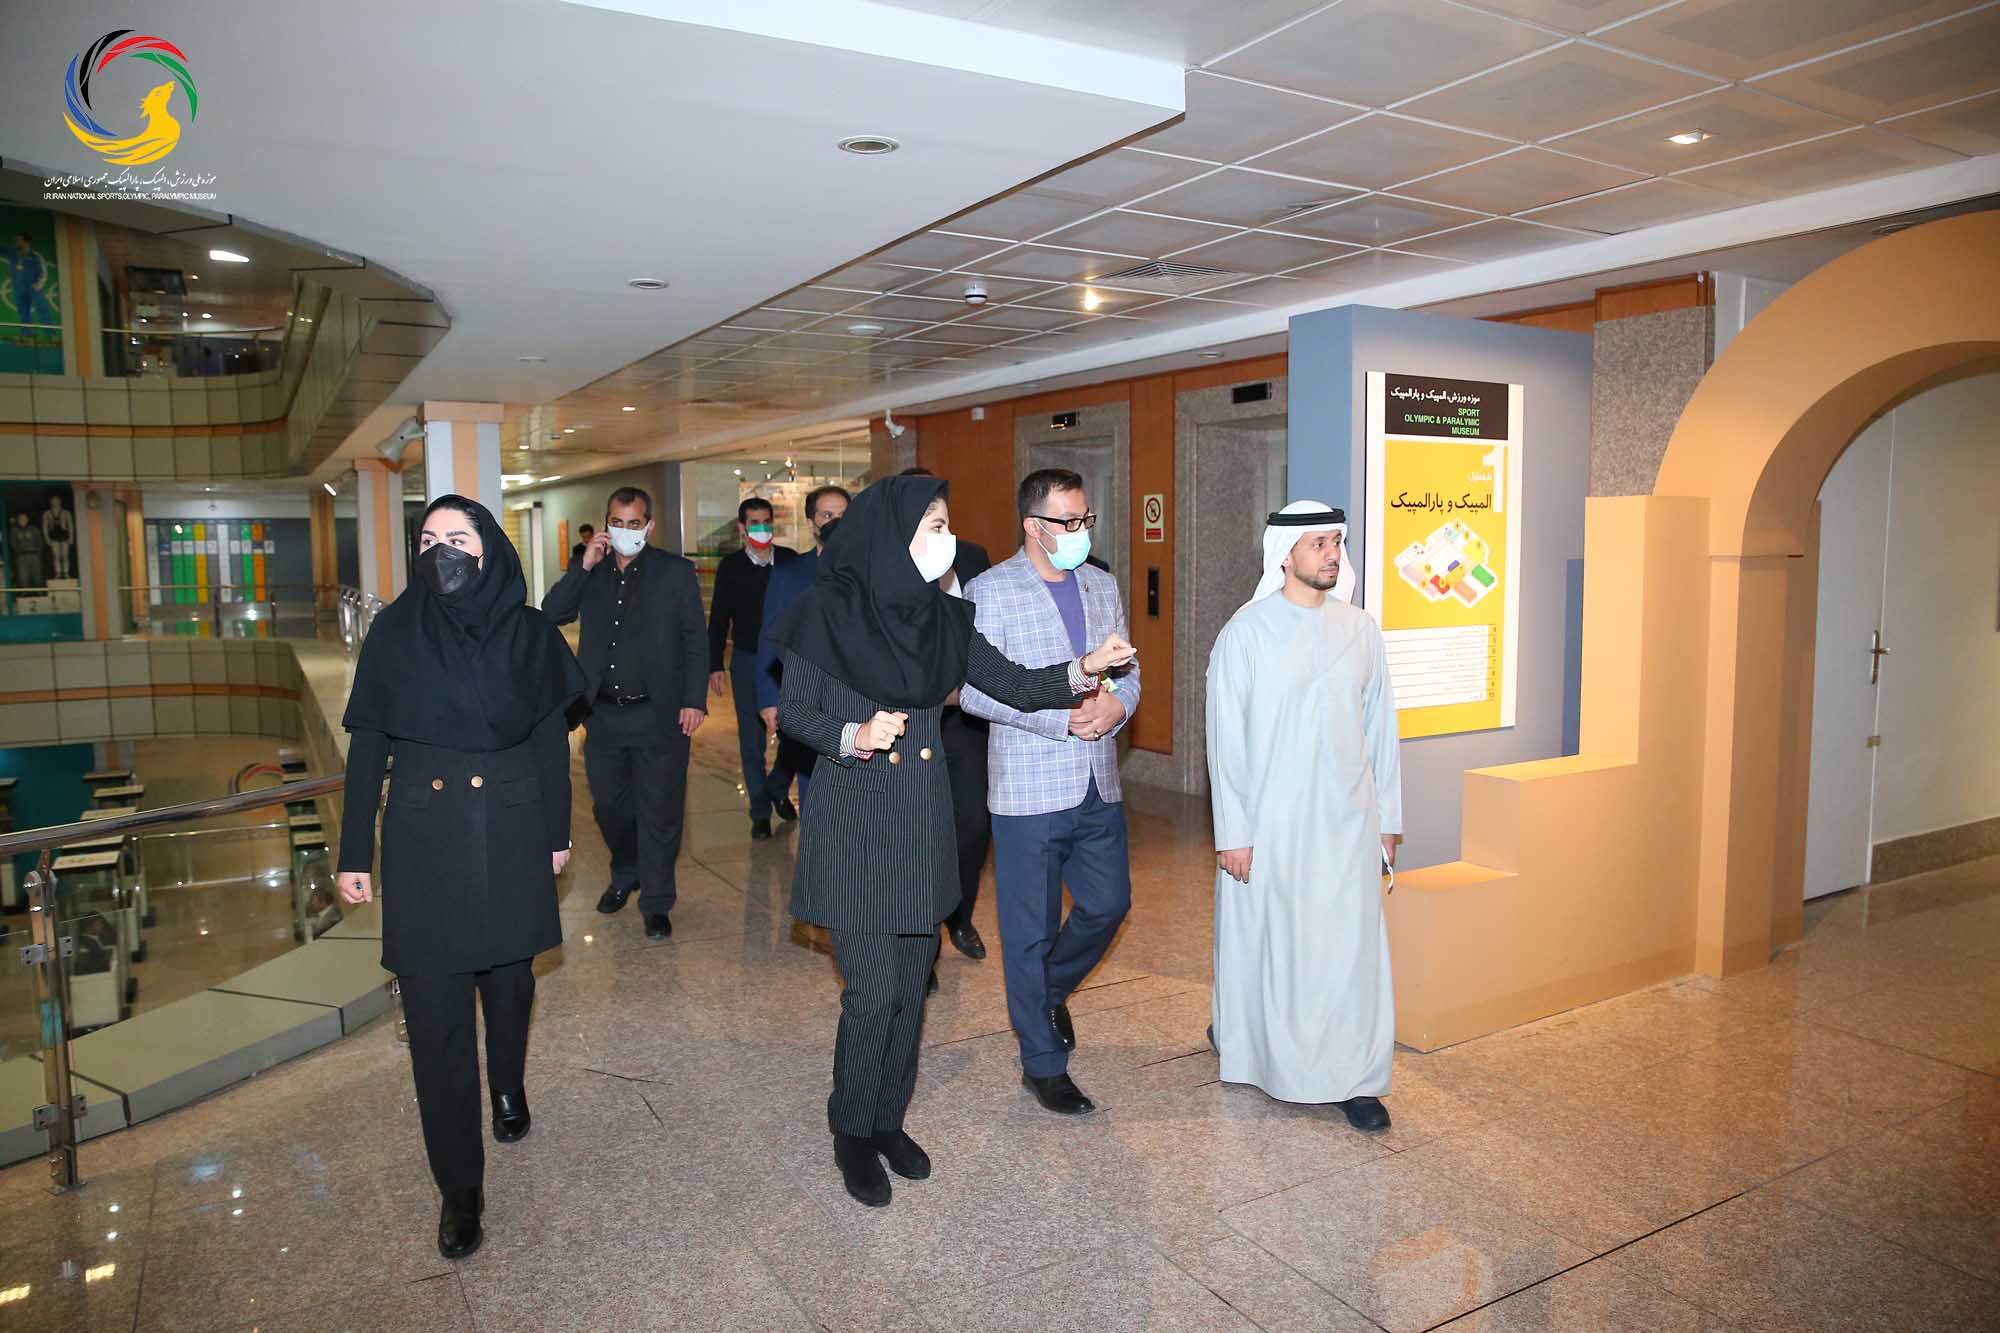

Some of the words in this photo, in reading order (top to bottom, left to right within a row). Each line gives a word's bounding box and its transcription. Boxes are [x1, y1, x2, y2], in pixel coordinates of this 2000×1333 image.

[1390, 387, 1420, 401] پارالمپیک
[1420, 392, 1426, 401] و
[1425, 389, 1447, 402] المپیک
[1467, 394, 1481, 405] موزه
[1458, 407, 1481, 417] SPORT
[1404, 414, 1436, 424] OLYMPIC
[1436, 416, 1441, 424] &
[1451, 426, 1480, 436] MUSEUM
[1482, 446, 1504, 513] 1
[1390, 491, 1444, 516] پارالمپیک
[1447, 499, 1453, 513] و
[1454, 492, 1493, 515] المپیک
